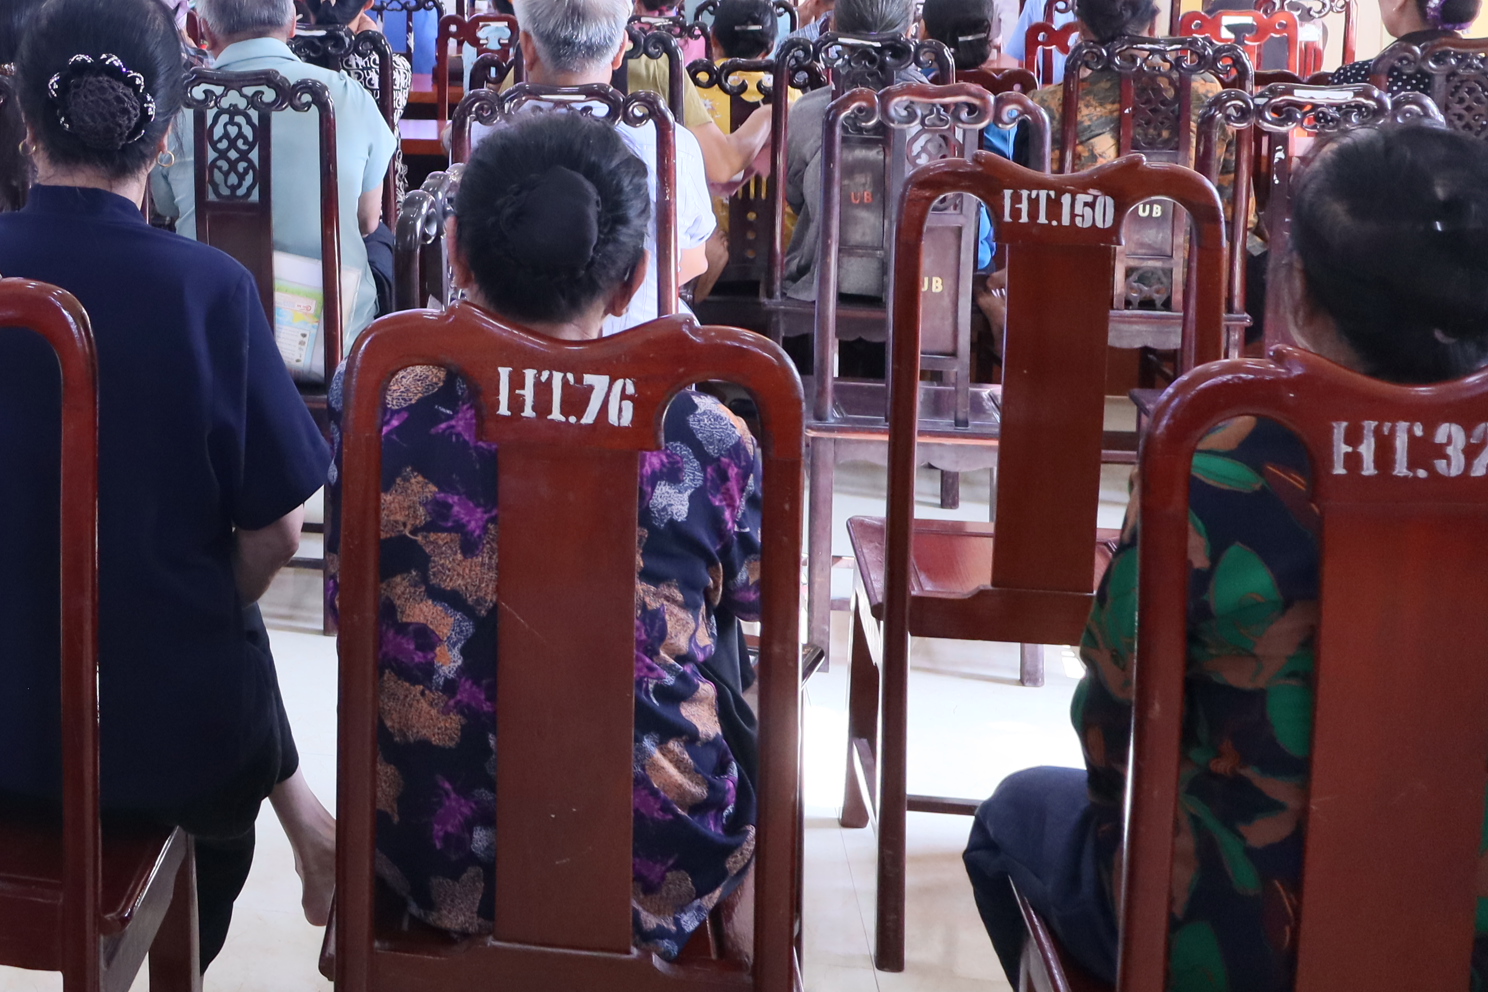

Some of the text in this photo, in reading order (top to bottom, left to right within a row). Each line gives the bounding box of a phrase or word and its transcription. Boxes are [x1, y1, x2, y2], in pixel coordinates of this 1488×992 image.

[851, 190, 873, 204] UB
[1003, 188, 1115, 229] HT.150
[1138, 203, 1162, 218] UB
[496, 366, 638, 427] HT.76
